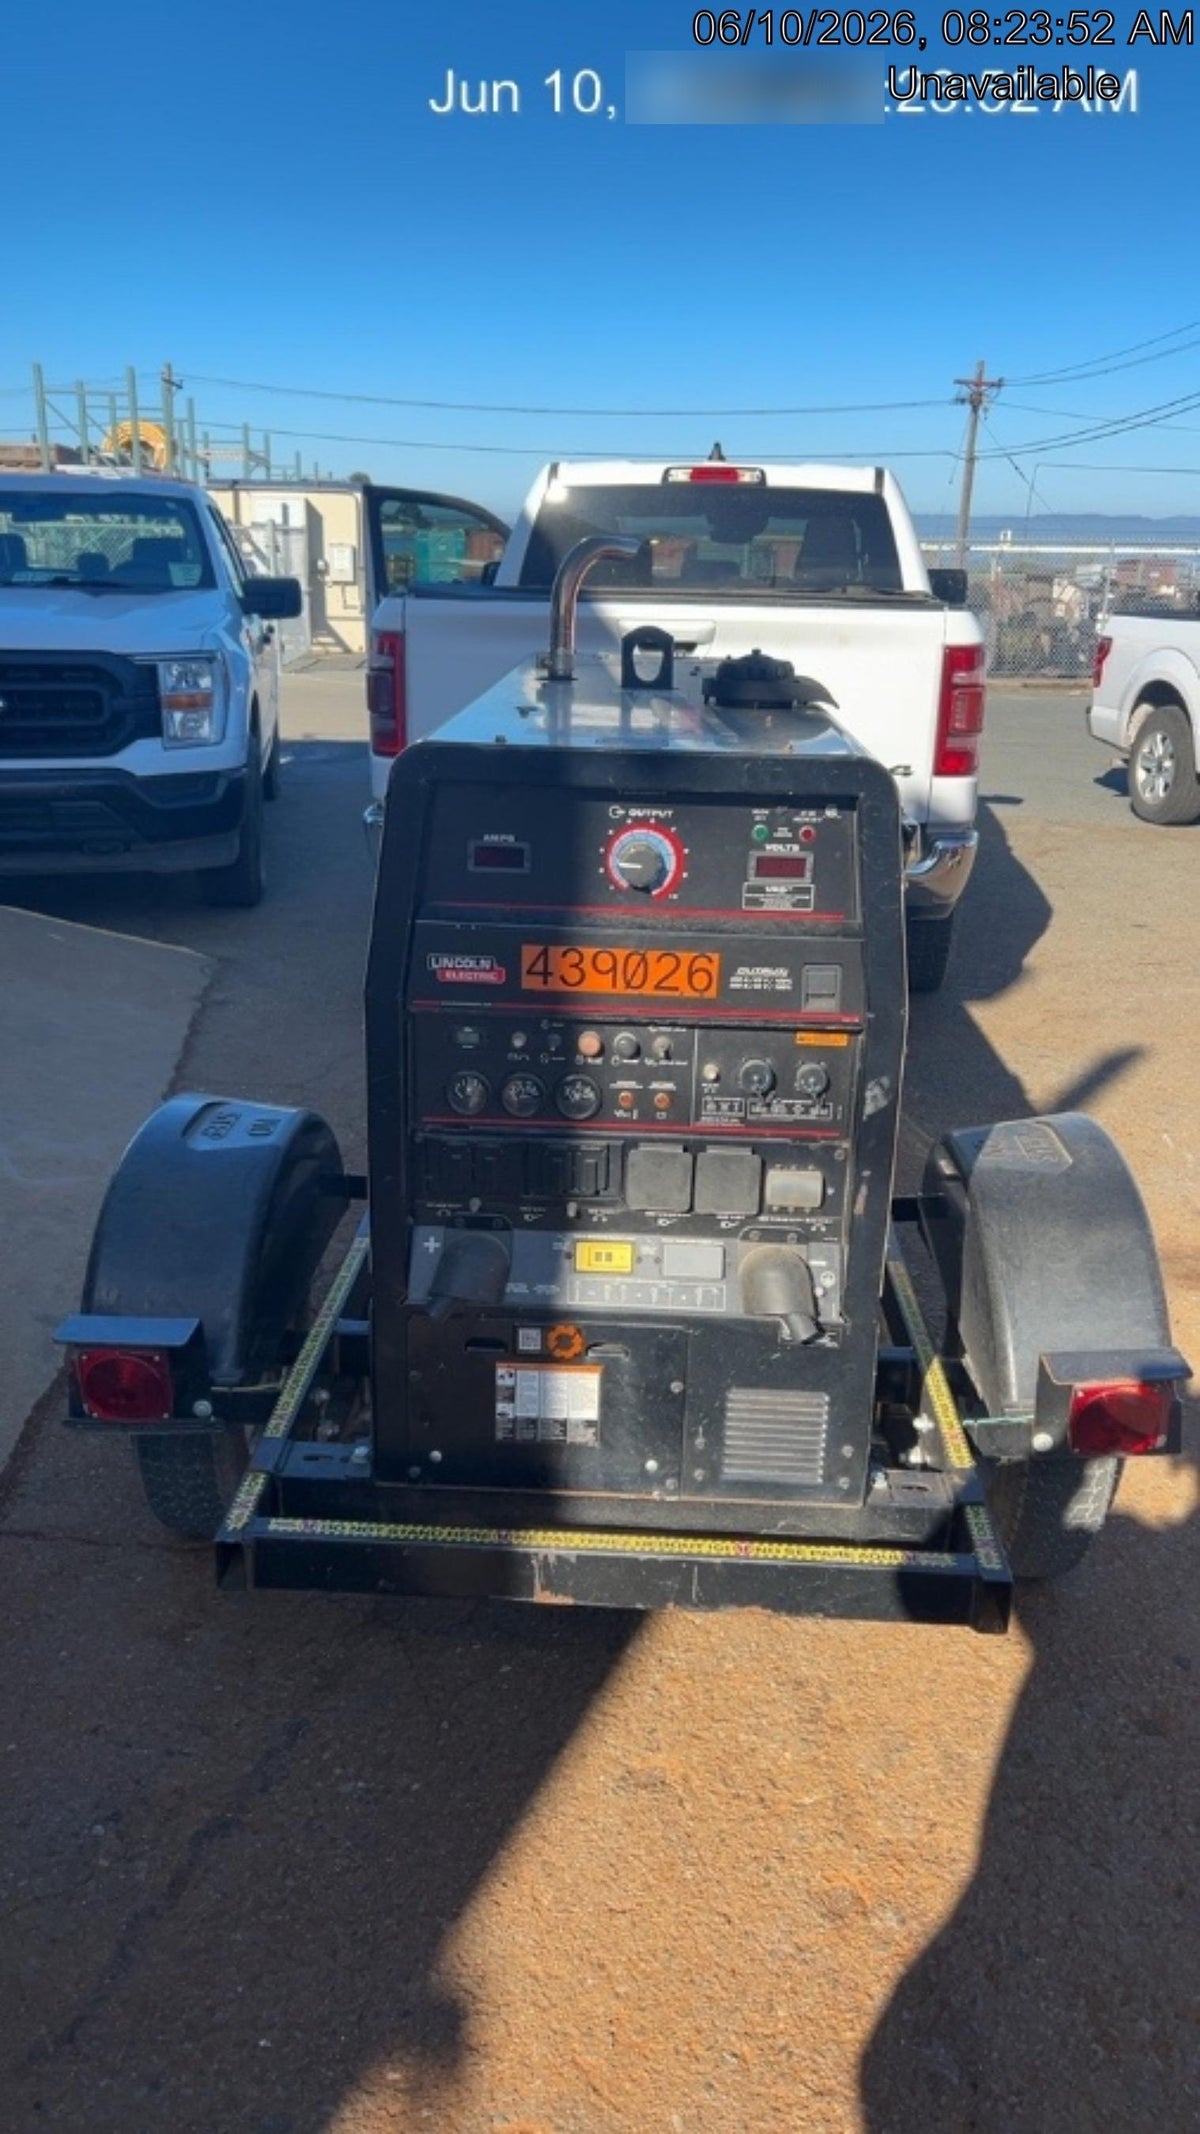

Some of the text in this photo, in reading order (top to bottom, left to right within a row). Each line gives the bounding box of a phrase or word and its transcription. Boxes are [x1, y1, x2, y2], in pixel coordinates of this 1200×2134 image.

[430, 956, 493, 971] LINCOLN
[525, 945, 714, 993] 439026
[444, 969, 500, 982] ELECTRIC
